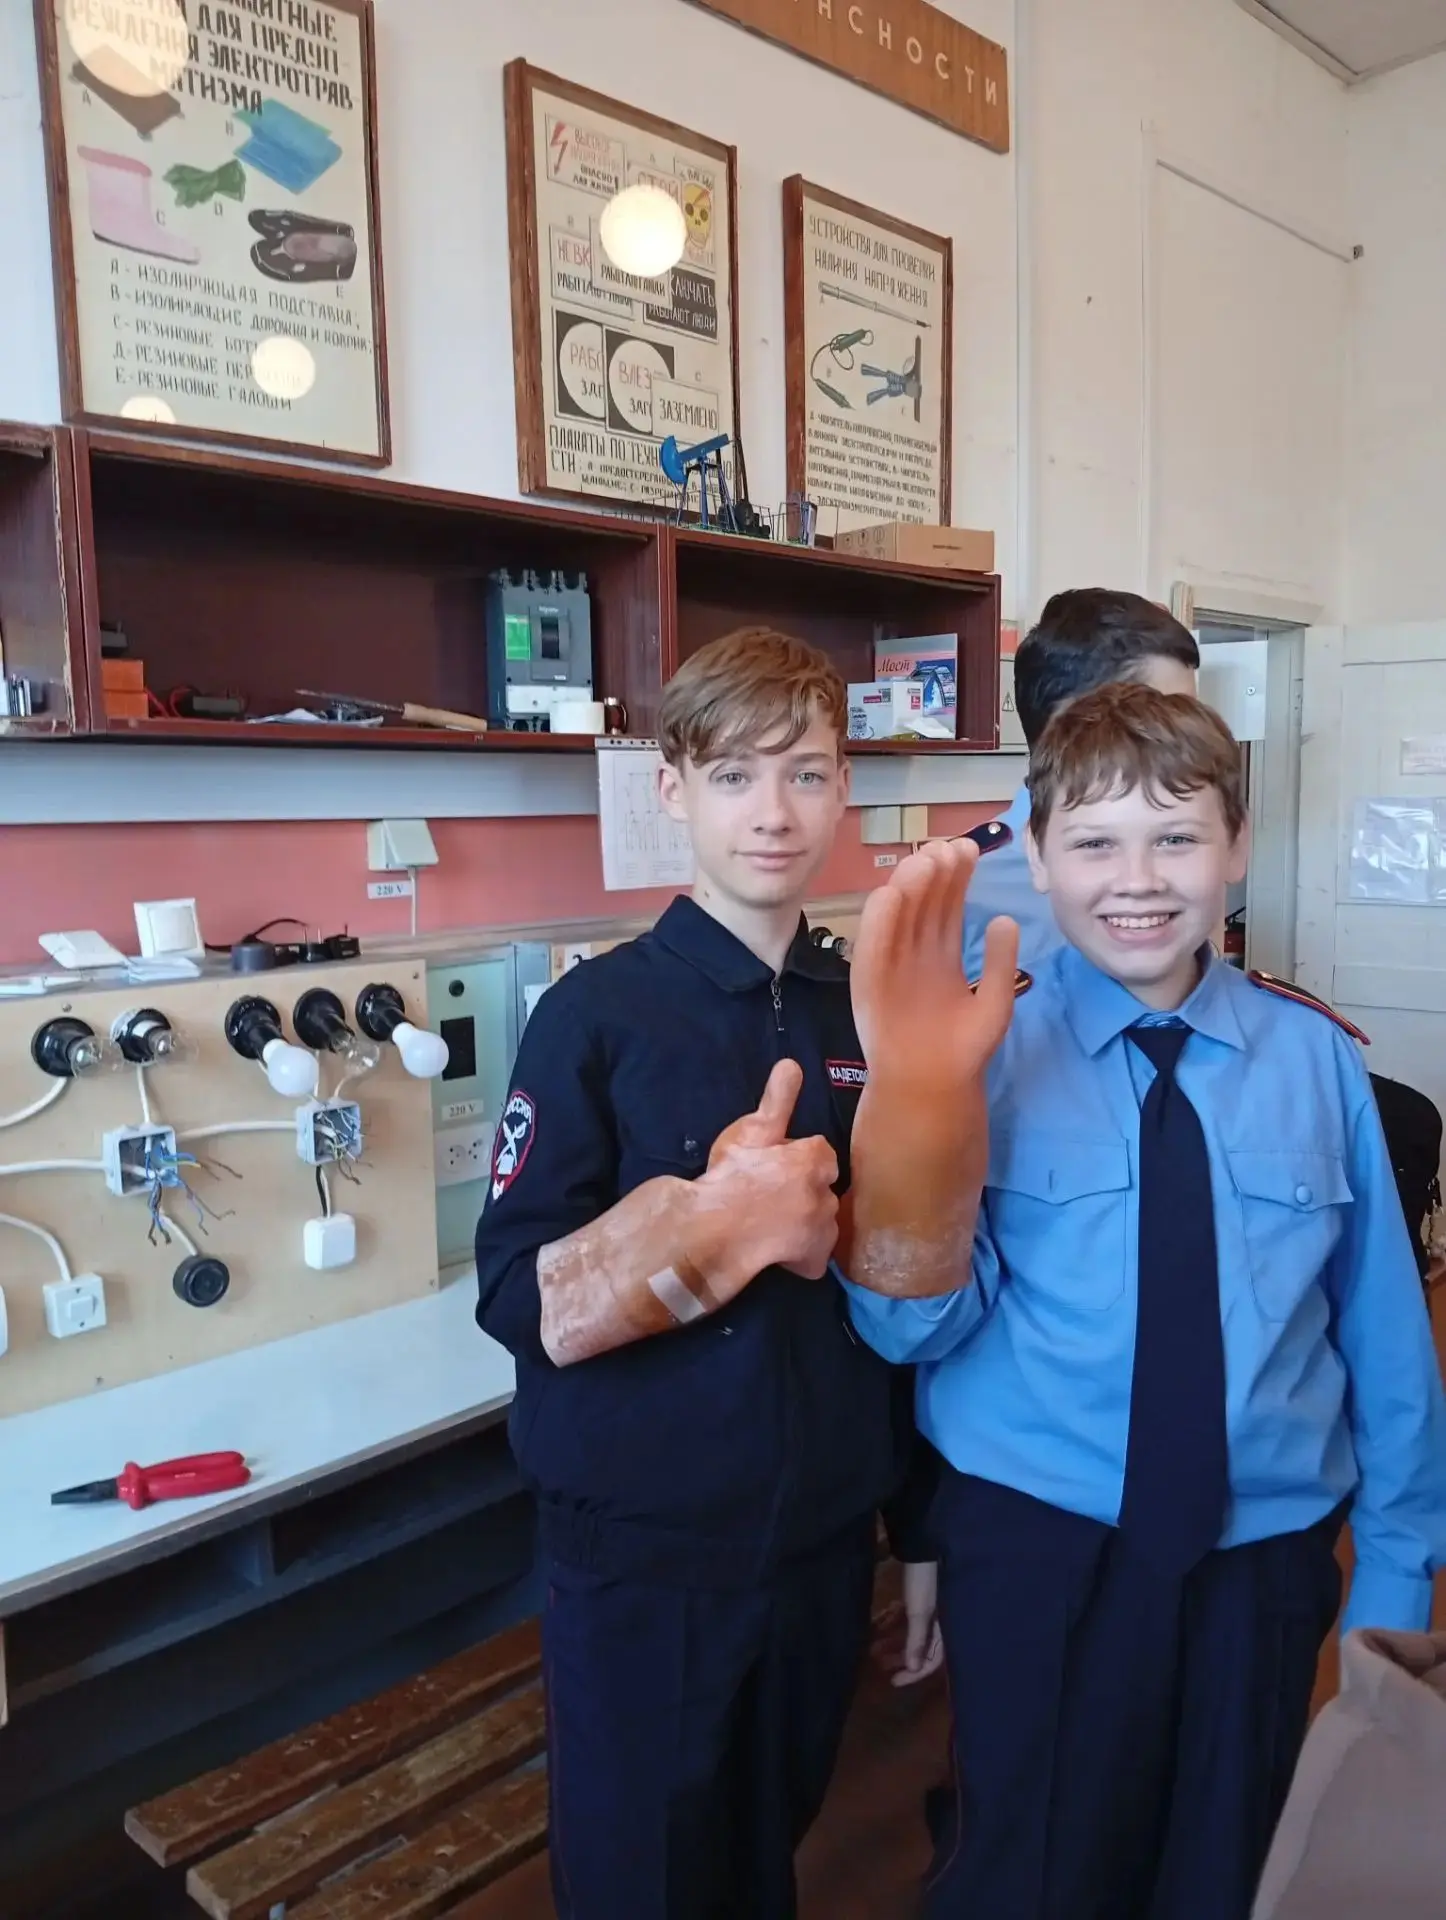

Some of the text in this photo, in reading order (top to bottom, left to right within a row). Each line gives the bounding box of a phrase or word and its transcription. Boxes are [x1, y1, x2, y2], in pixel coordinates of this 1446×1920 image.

[197, 3, 242, 43] ДЛЯ
[659, 397, 718, 431] ЗАЗЕМЛЕНО
[549, 424, 605, 457] ПЛАКАТЫ
[610, 438, 627, 461] ПО
[628, 441, 662, 469] ТЕХН
[877, 658, 911, 673] Мост
[449, 1104, 466, 1118] 220
